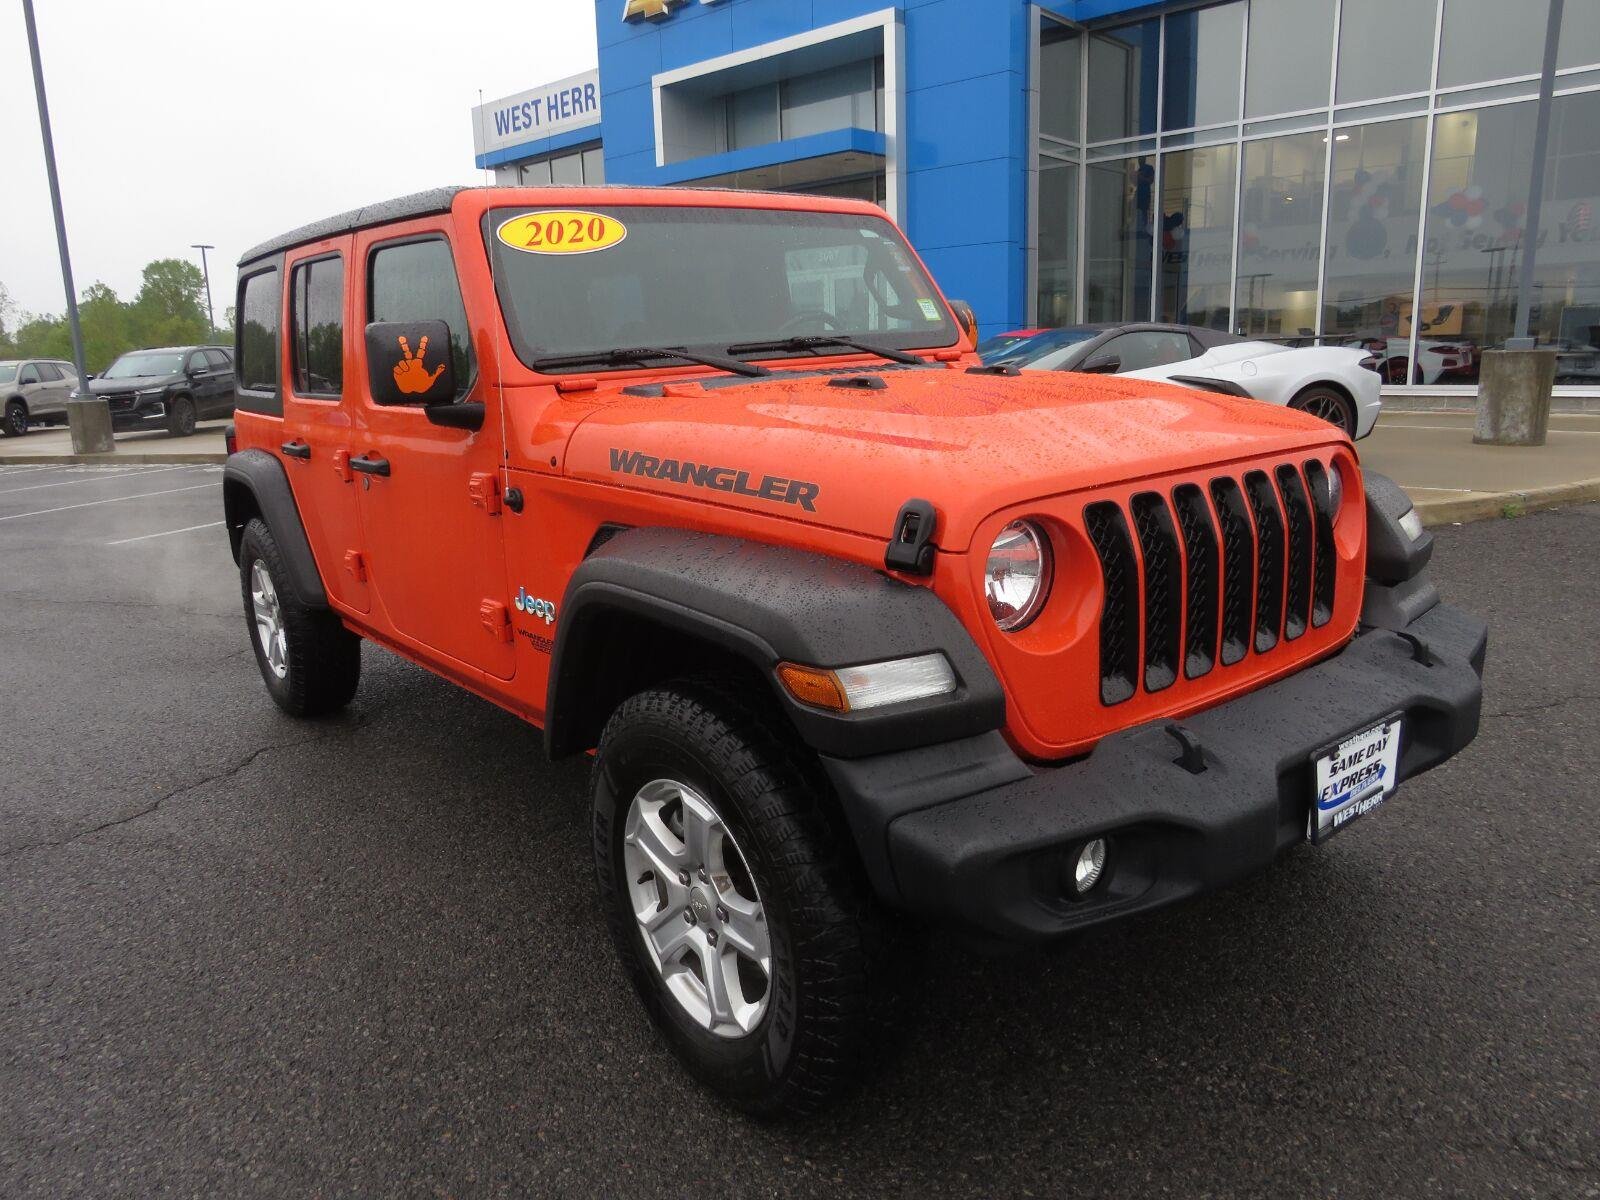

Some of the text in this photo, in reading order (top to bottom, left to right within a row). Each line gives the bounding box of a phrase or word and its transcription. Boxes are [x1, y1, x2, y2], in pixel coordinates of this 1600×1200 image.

[494, 83, 597, 137] WEST HERR
[526, 217, 605, 247] 2020
[609, 448, 820, 512] WRANGLER
[514, 586, 556, 625] Jeep
[1329, 736, 1389, 778] SAME DAY
[1321, 758, 1382, 802] EXPRESS
